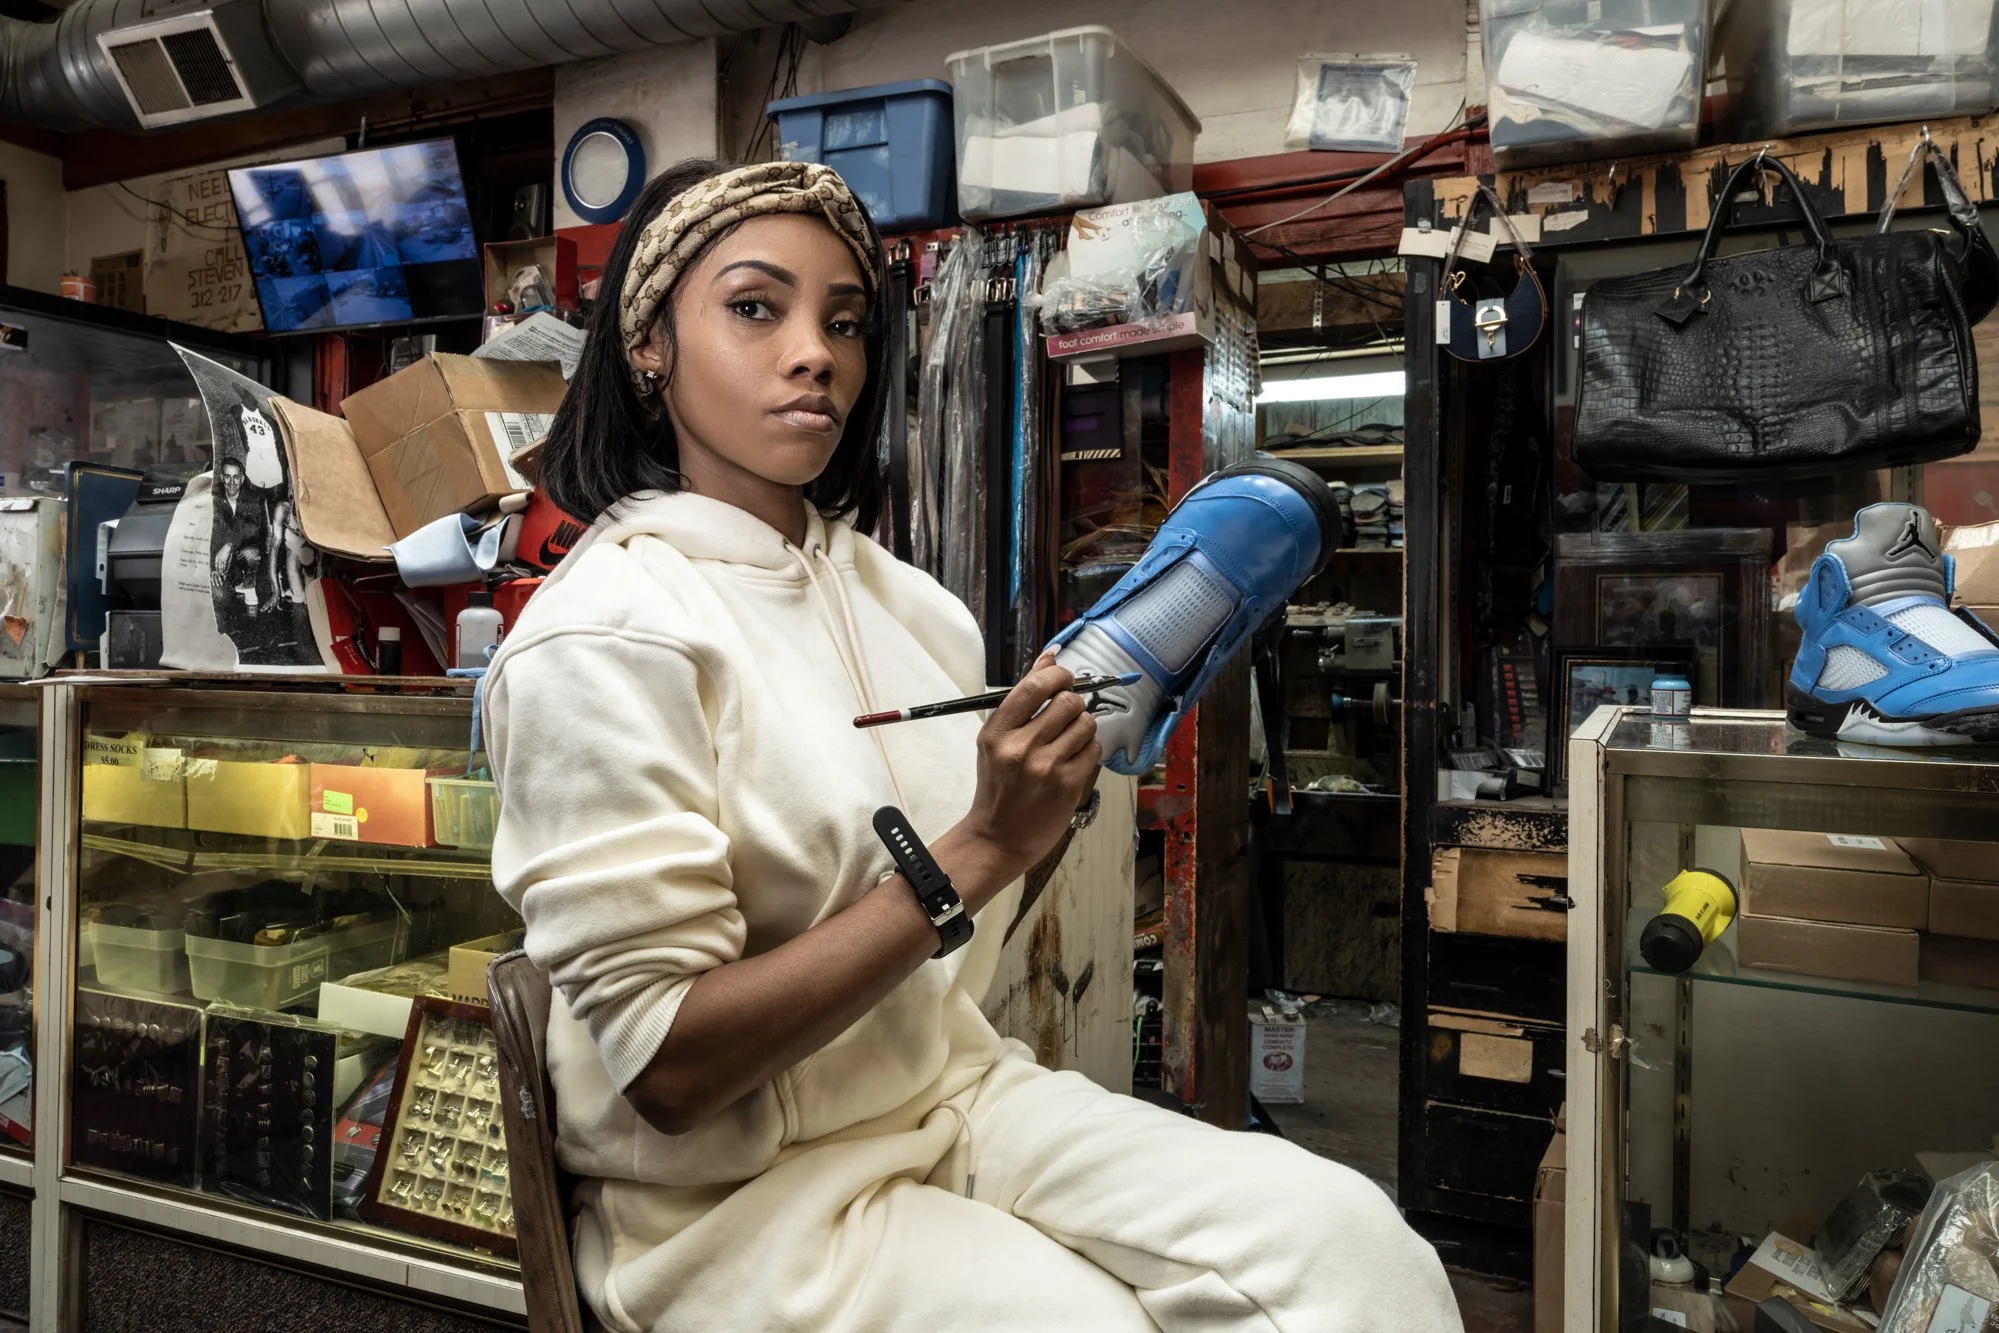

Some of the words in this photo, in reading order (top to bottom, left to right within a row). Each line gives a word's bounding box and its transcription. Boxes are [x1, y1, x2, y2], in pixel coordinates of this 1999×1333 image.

[1088, 207, 1129, 221] Comfort
[205, 244, 243, 267] CALL
[188, 263, 243, 291] STEVEN
[191, 289, 213, 309] 312
[218, 285, 242, 304] 217
[1058, 339, 1078, 349] foot
[1080, 331, 1117, 346] comfort
[1120, 327, 1150, 339] made
[1152, 320, 1185, 333] sple
[250, 424, 265, 435] 43
[152, 486, 181, 495] SHARP
[84, 740, 109, 751] DRESS
[110, 743, 138, 755] SOCKS
[101, 756, 119, 765] $5.00
